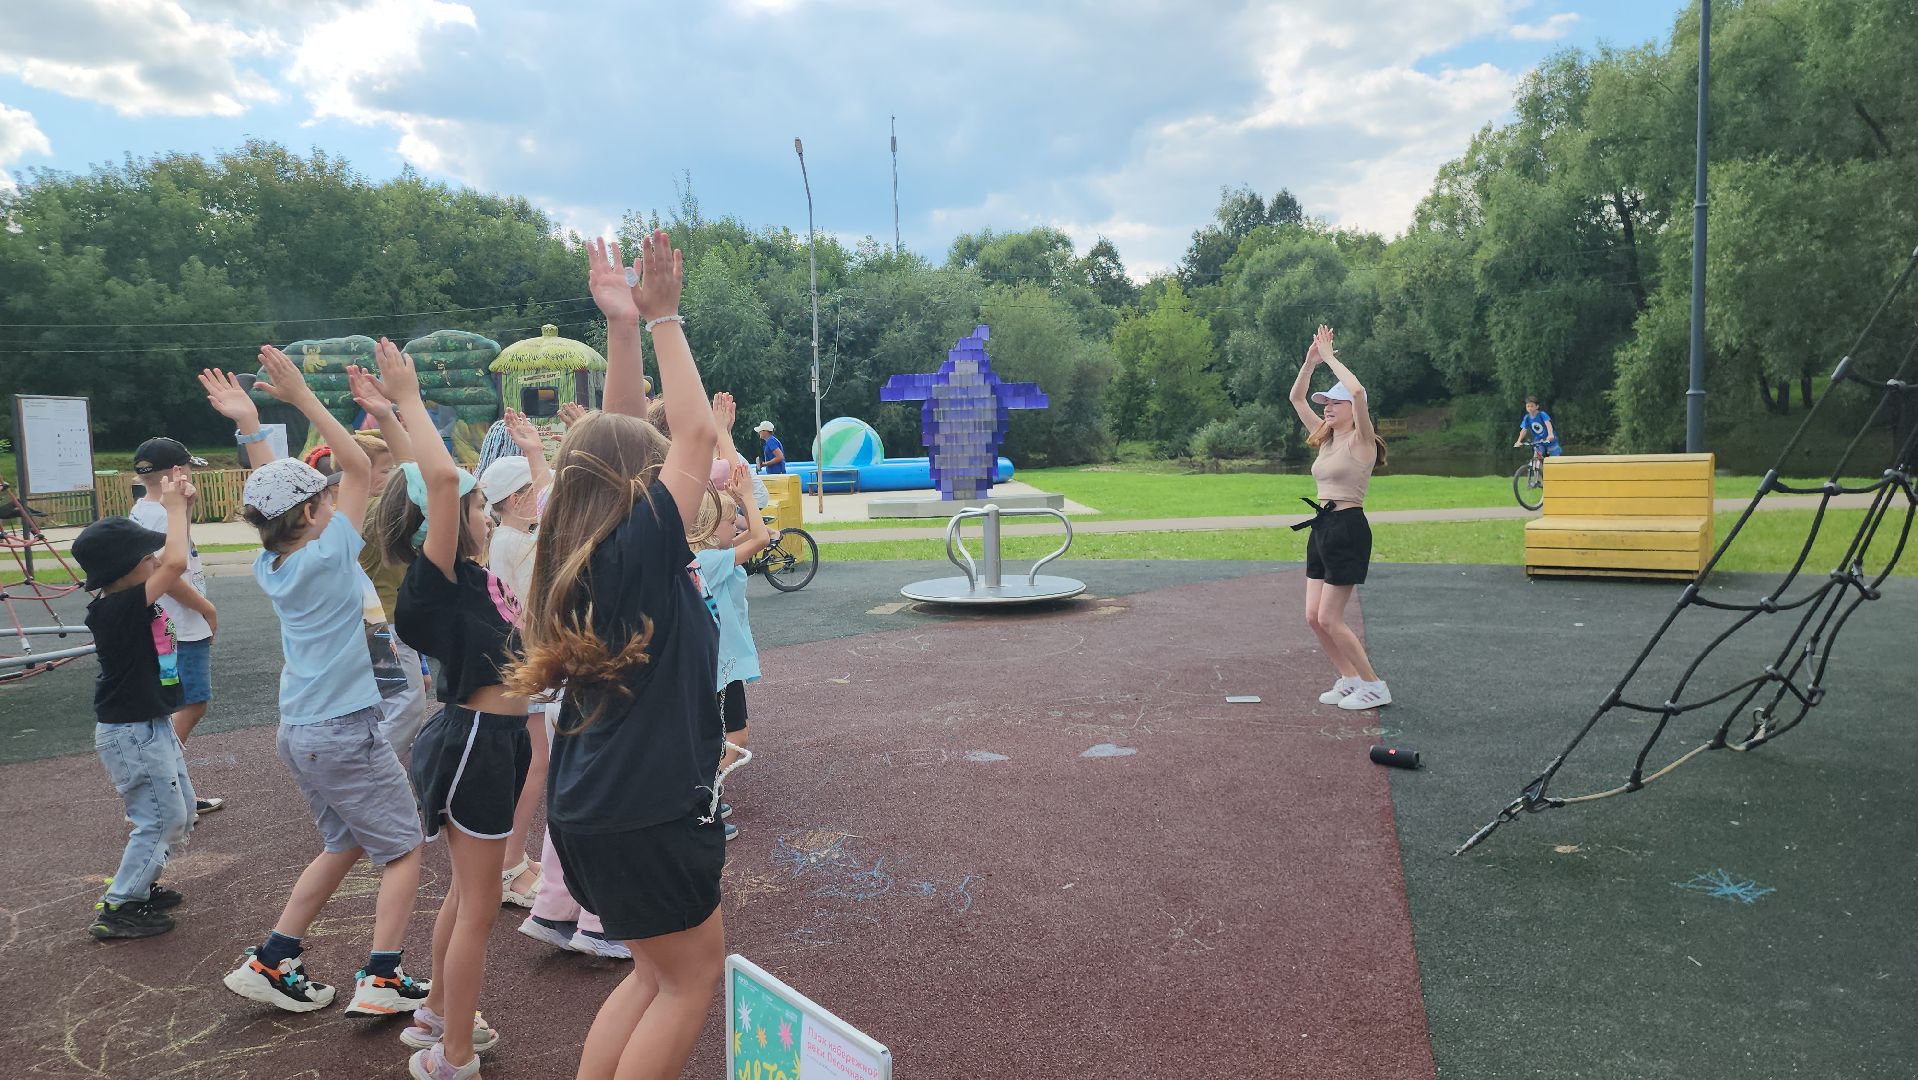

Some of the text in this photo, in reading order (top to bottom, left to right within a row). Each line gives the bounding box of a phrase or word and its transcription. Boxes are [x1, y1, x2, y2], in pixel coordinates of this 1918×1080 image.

[807, 1041, 825, 1058] реки
[807, 1025, 827, 1046] Парк
[828, 1041, 878, 1078] набережной
